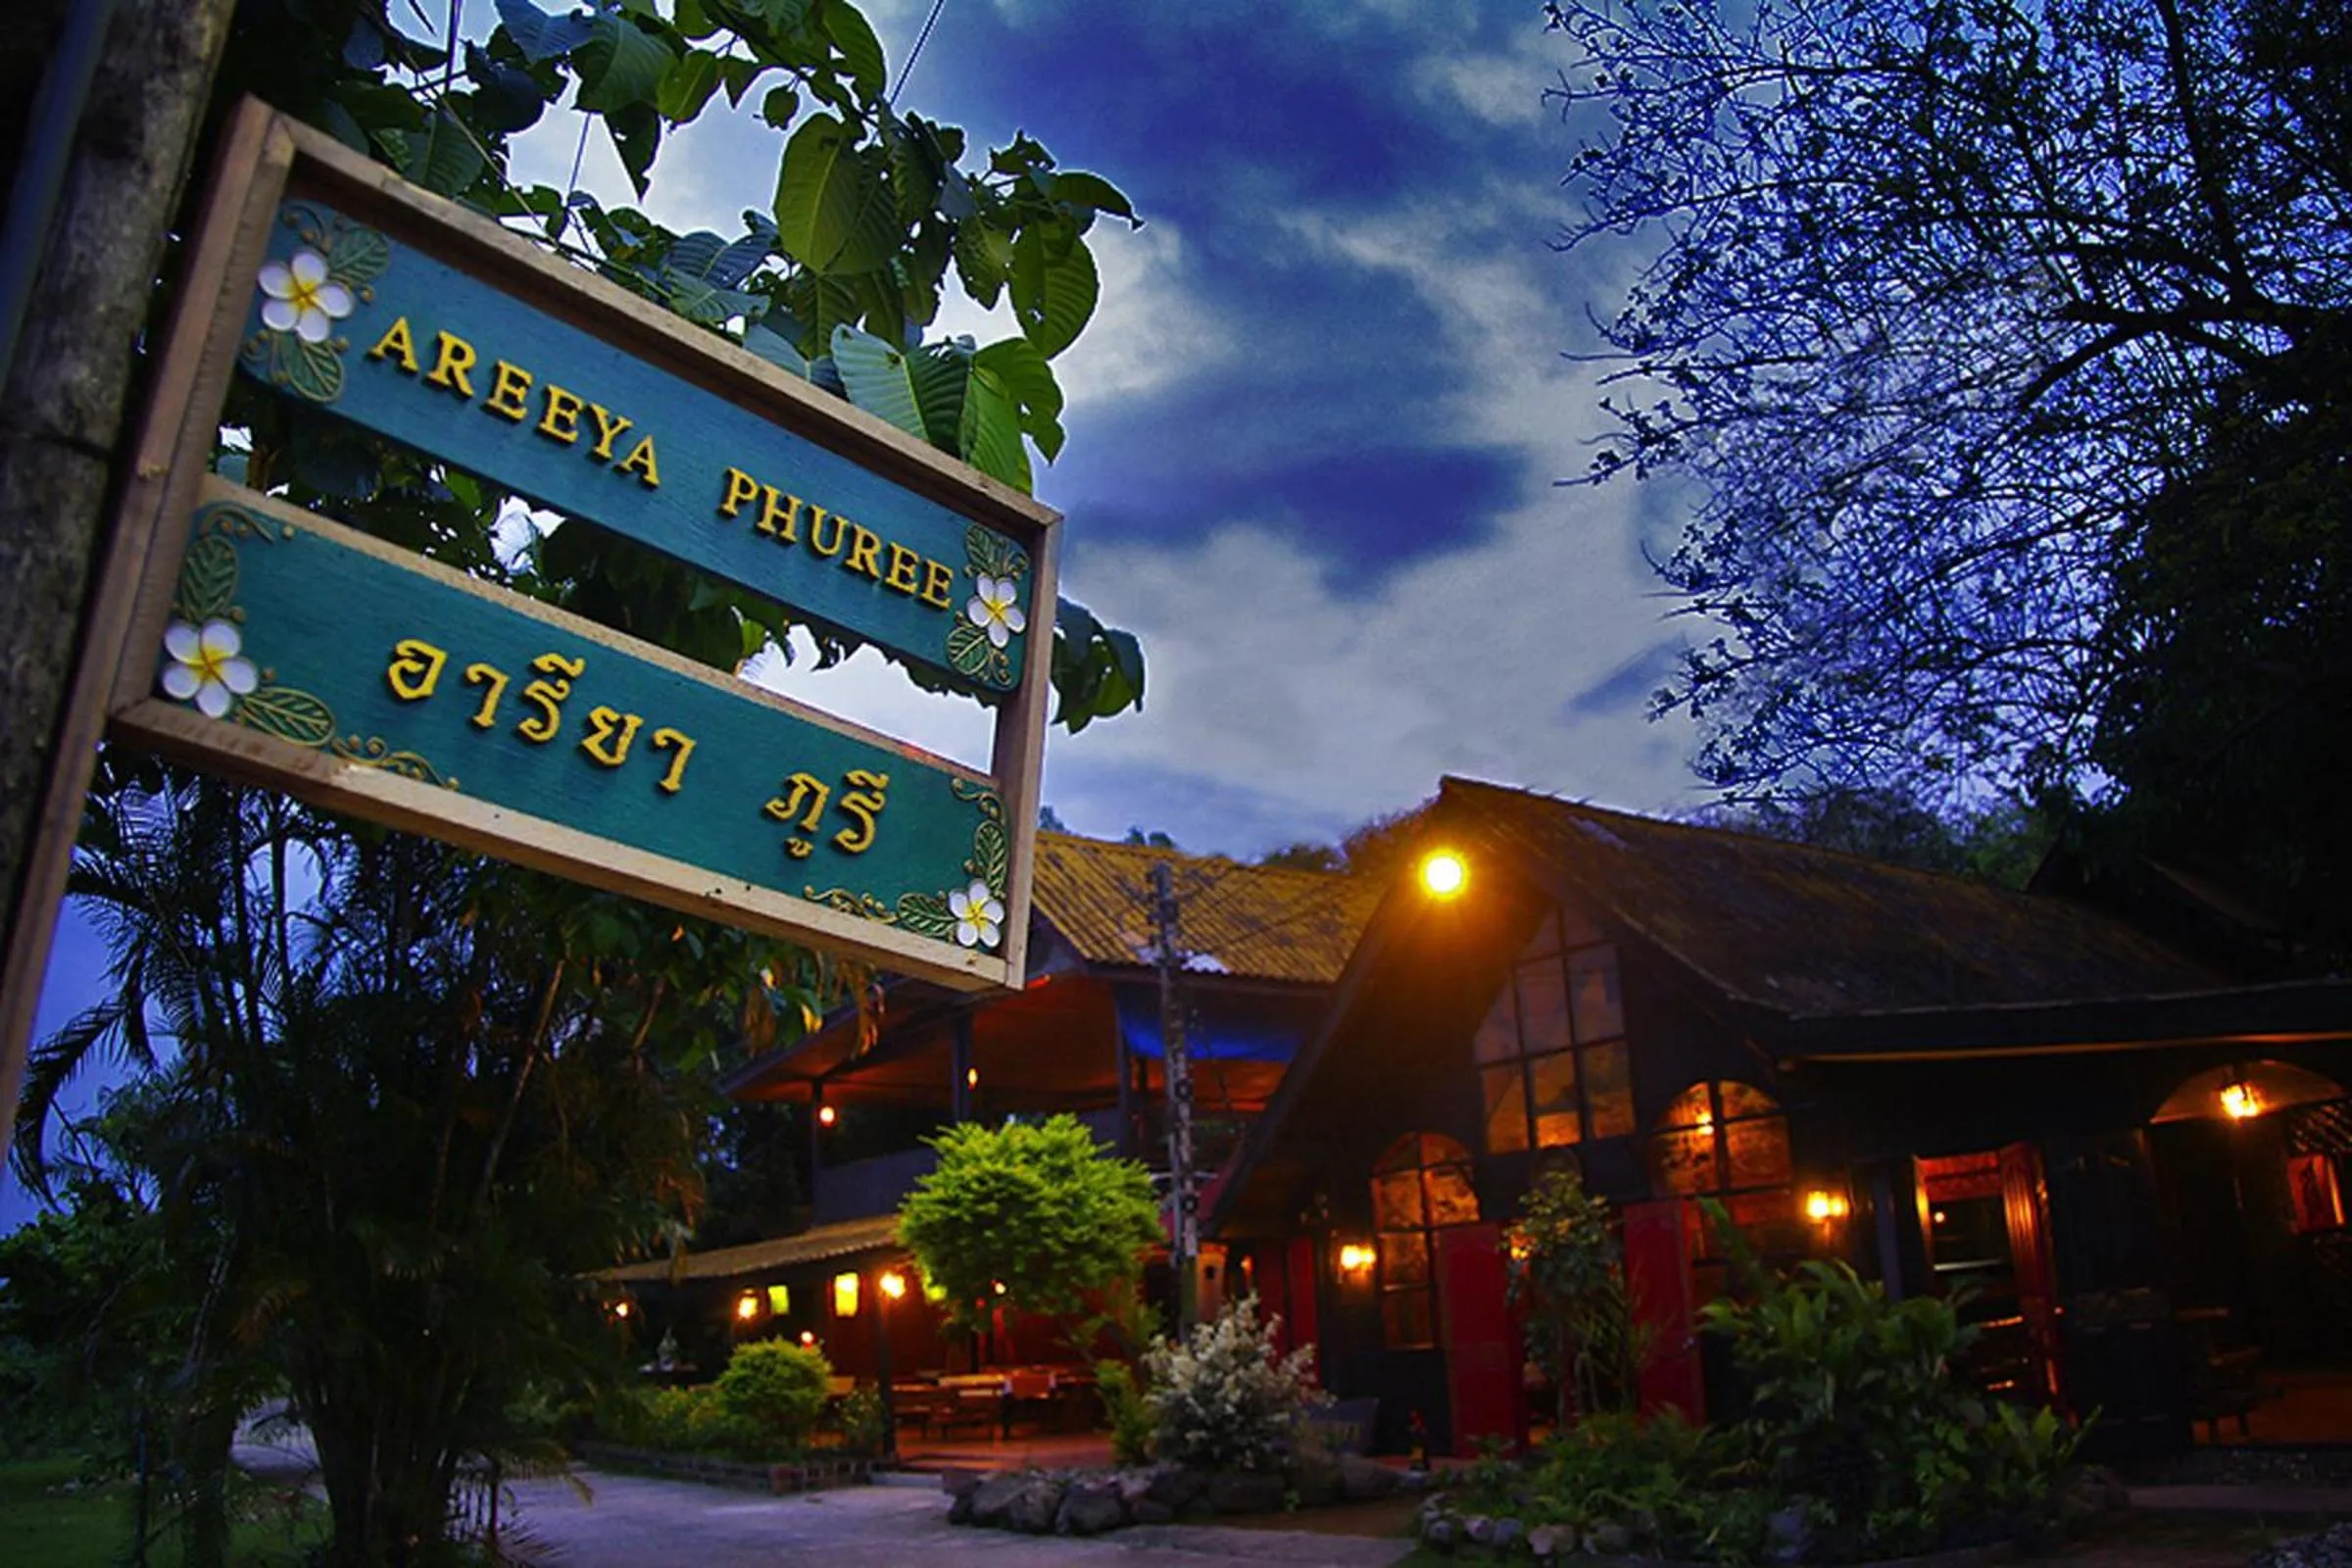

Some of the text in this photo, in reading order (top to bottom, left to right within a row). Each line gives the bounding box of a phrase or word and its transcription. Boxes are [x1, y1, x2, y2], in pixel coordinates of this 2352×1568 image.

[368, 316, 956, 609] AREEYA PHUREE
[388, 639, 697, 793] อารียา
